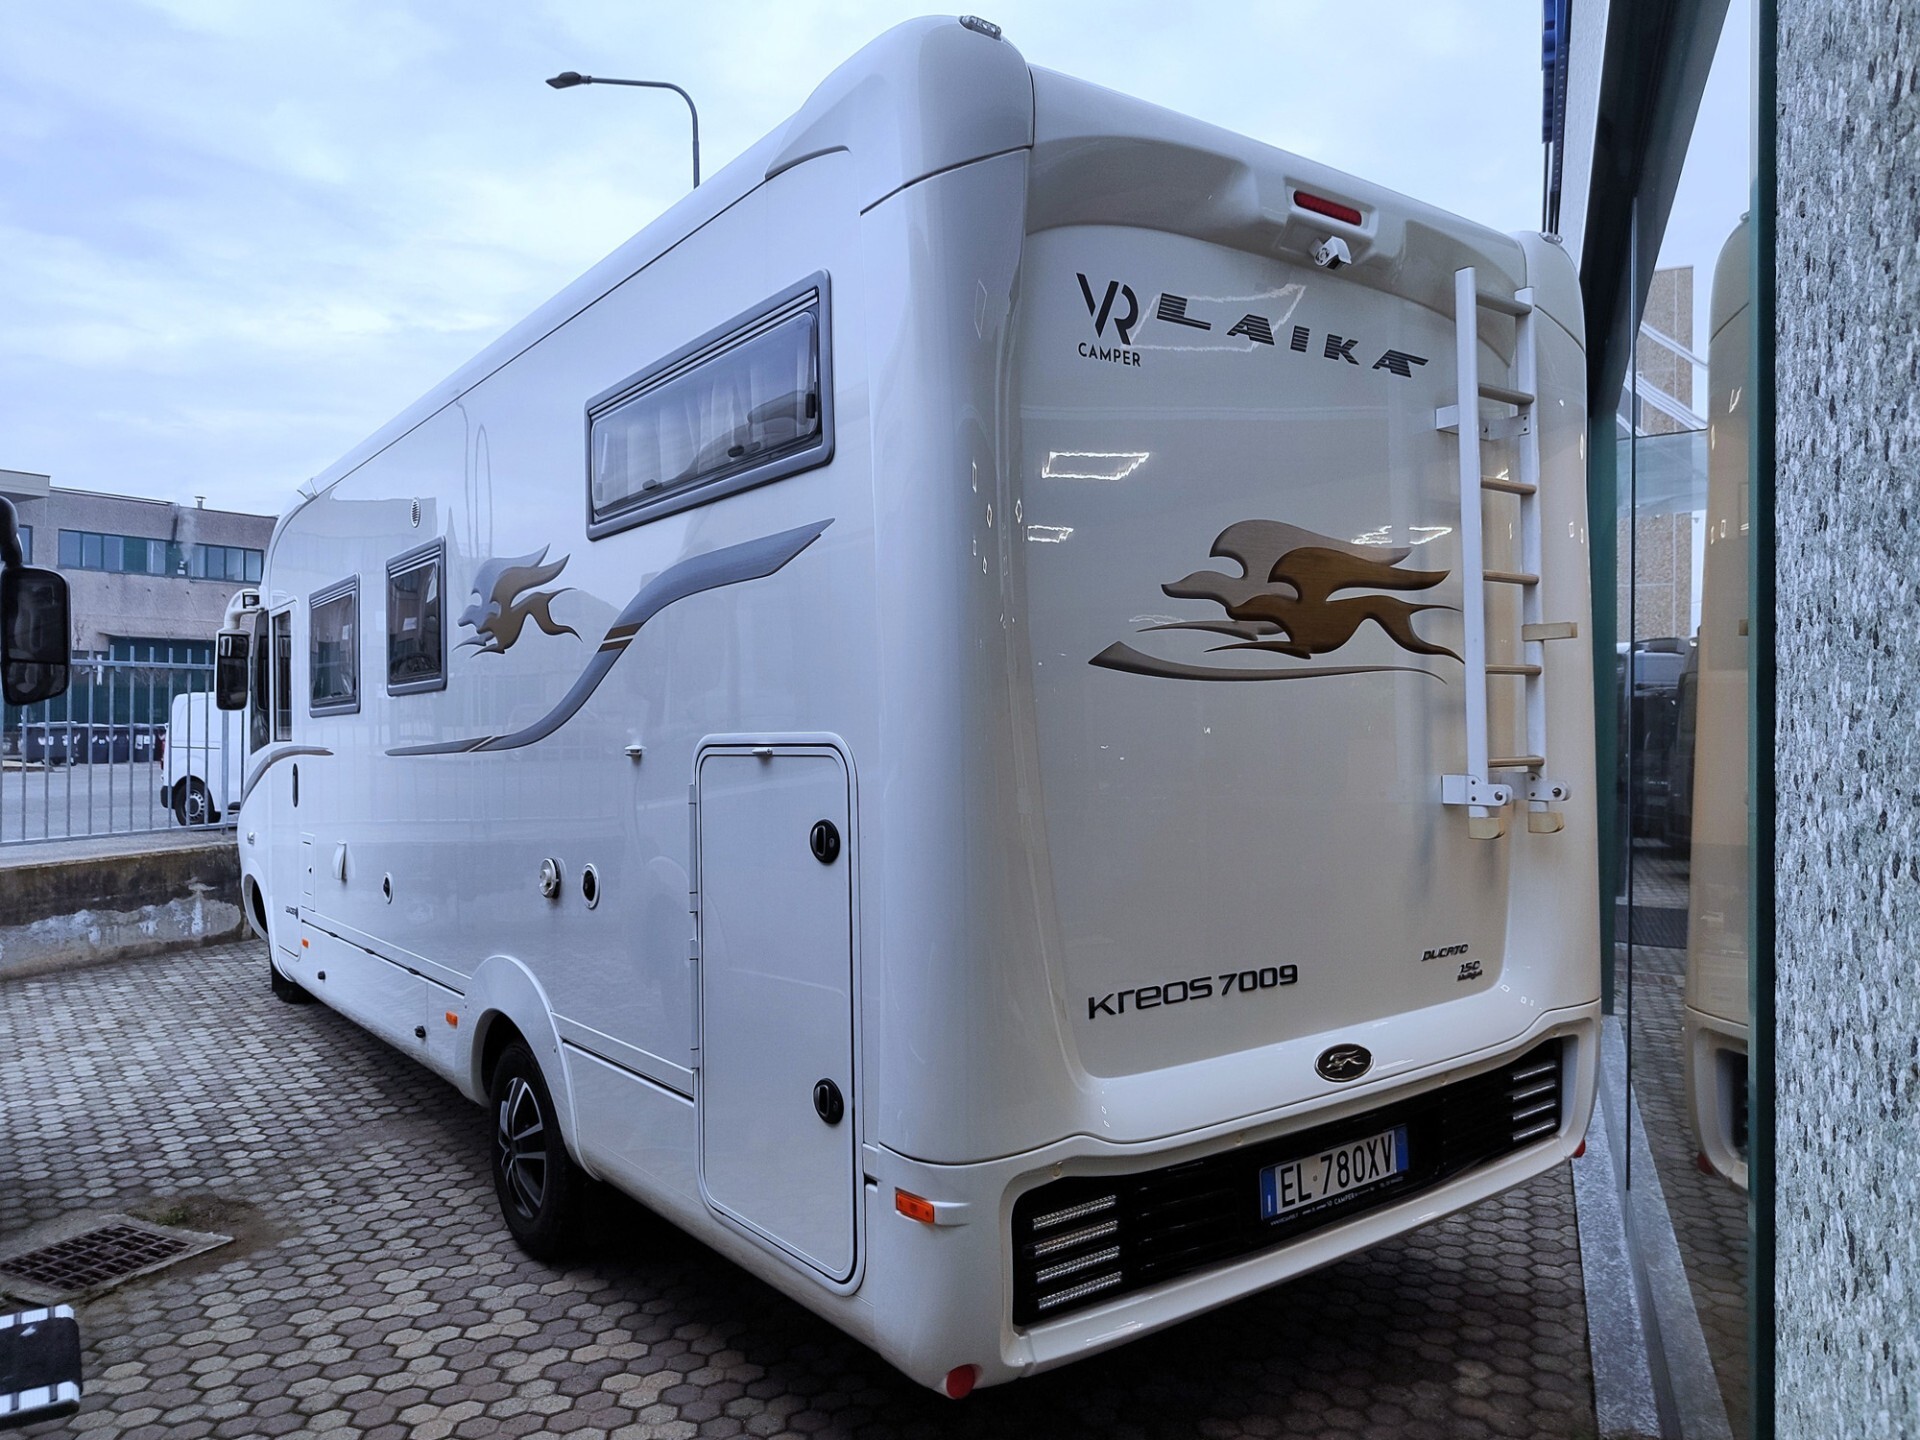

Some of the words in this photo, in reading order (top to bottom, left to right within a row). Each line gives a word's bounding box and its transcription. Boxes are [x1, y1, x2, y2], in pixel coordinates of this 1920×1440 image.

[1077, 273, 1139, 345] VR
[1157, 293, 1429, 378] LAIKA
[1078, 342, 1141, 367] CAMPER
[1422, 944, 1468, 961] DUCATO
[1218, 963, 1298, 997] 7009
[1281, 1163, 1311, 1208] EL
[1321, 1134, 1392, 1195] 780XV
